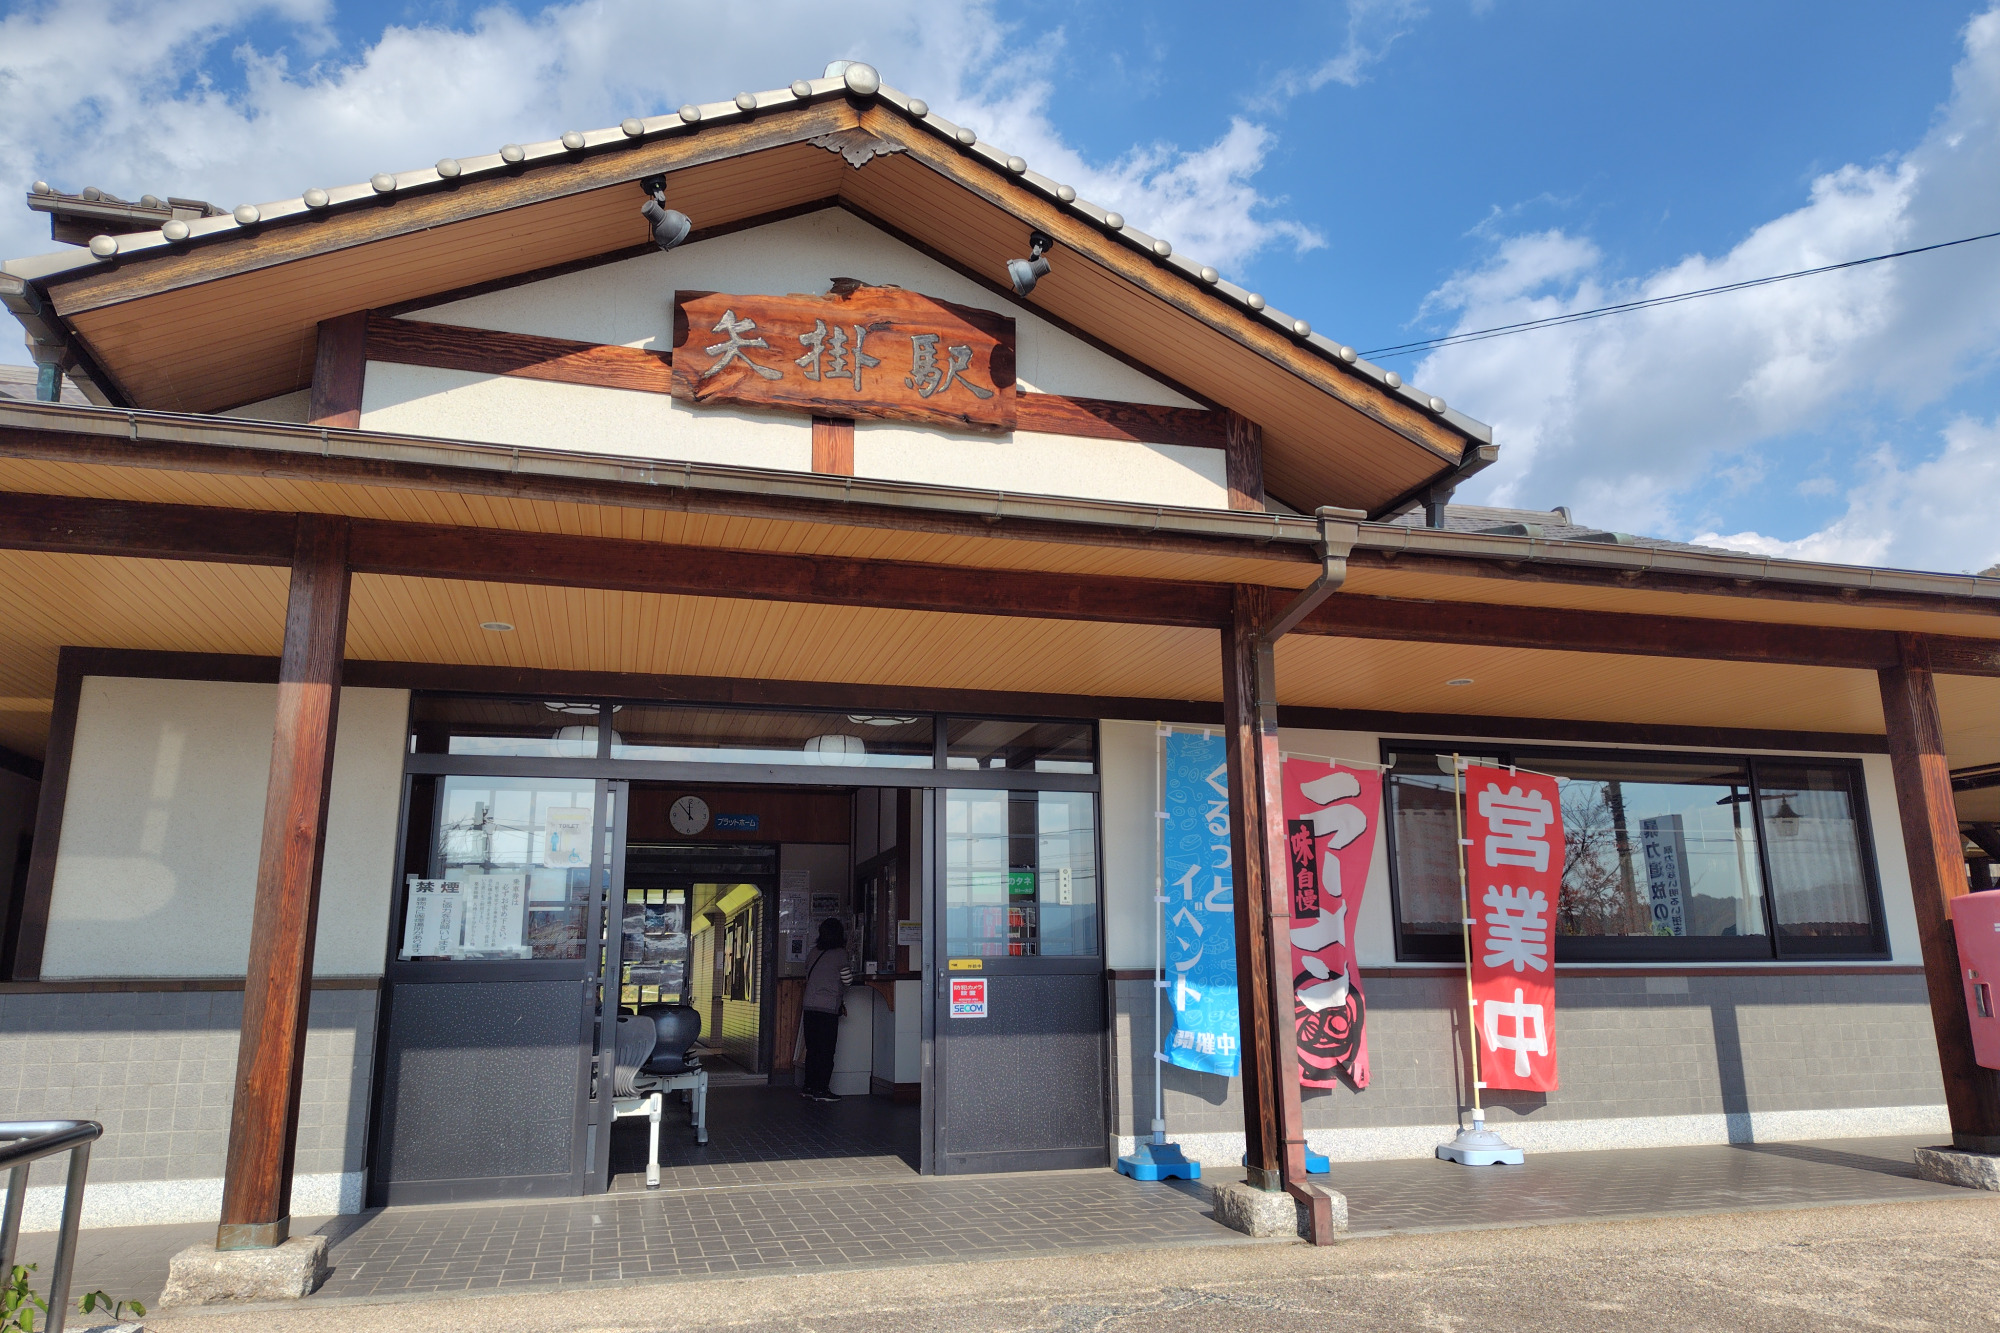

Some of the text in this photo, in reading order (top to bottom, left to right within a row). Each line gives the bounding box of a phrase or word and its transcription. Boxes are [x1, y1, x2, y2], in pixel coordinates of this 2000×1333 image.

[701, 308, 994, 399] 矢掛駅
[717, 818, 756, 827] プラットホーム
[1204, 762, 1234, 912] くるっと
[416, 881, 460, 893] 禁煙
[1290, 824, 1319, 912] 味自慢
[1290, 771, 1368, 1013] ラーメン
[1172, 863, 1204, 1012] イベント
[1477, 781, 1554, 1078] 営業中
[954, 1004, 983, 1012] SECOM
[1173, 1029, 1236, 1056] 開催中
